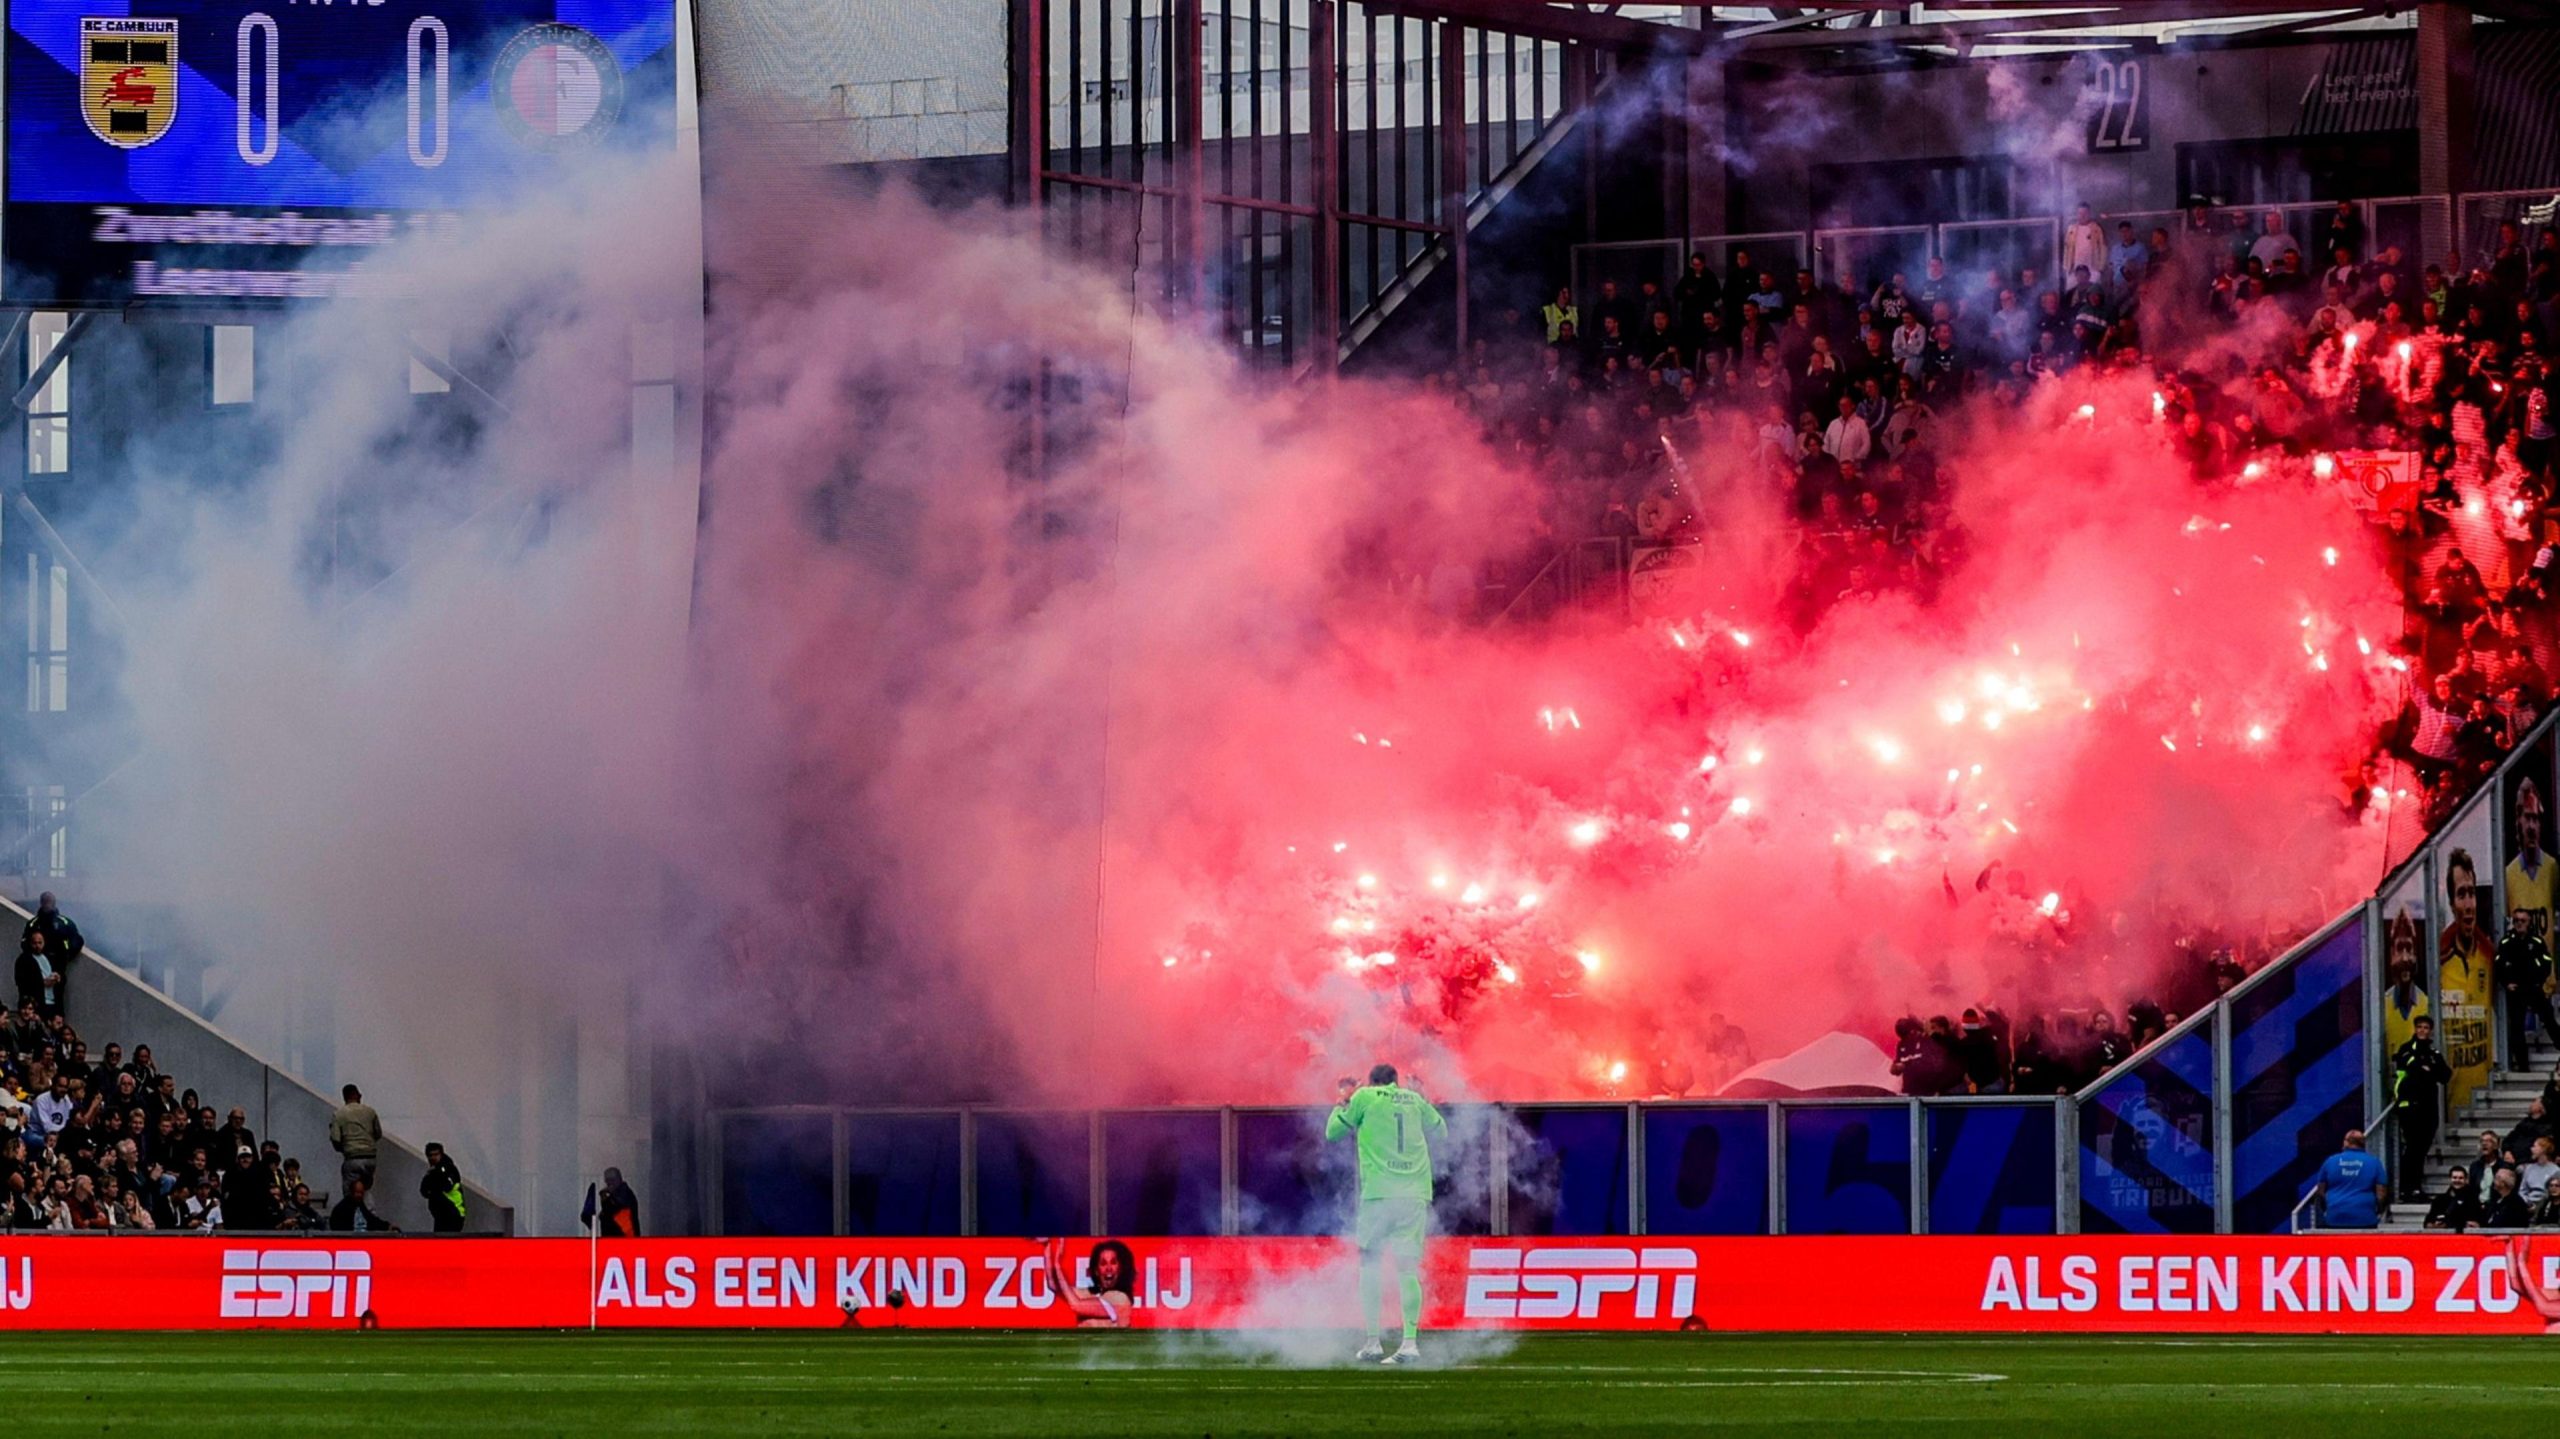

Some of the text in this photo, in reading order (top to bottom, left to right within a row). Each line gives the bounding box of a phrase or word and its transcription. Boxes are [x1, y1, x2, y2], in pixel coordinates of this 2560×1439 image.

[237, 12, 279, 166] 0
[407, 15, 449, 169] 0
[2095, 61, 2142, 148] 22
[1394, 1112, 1404, 1154] 1
[2110, 1187, 2215, 1208] TRIBUNE
[220, 1249, 371, 1318] ESPN
[597, 1257, 697, 1308] ALS
[714, 1257, 786, 1308] EEN
[835, 1257, 967, 1308] KIND
[1463, 1248, 1698, 1319] ESPN
[1980, 1256, 2098, 1312] ALS
[2119, 1256, 2239, 1312] EEN
[2261, 1256, 2414, 1313] KIND
[2434, 1255, 2520, 1313] ZO
